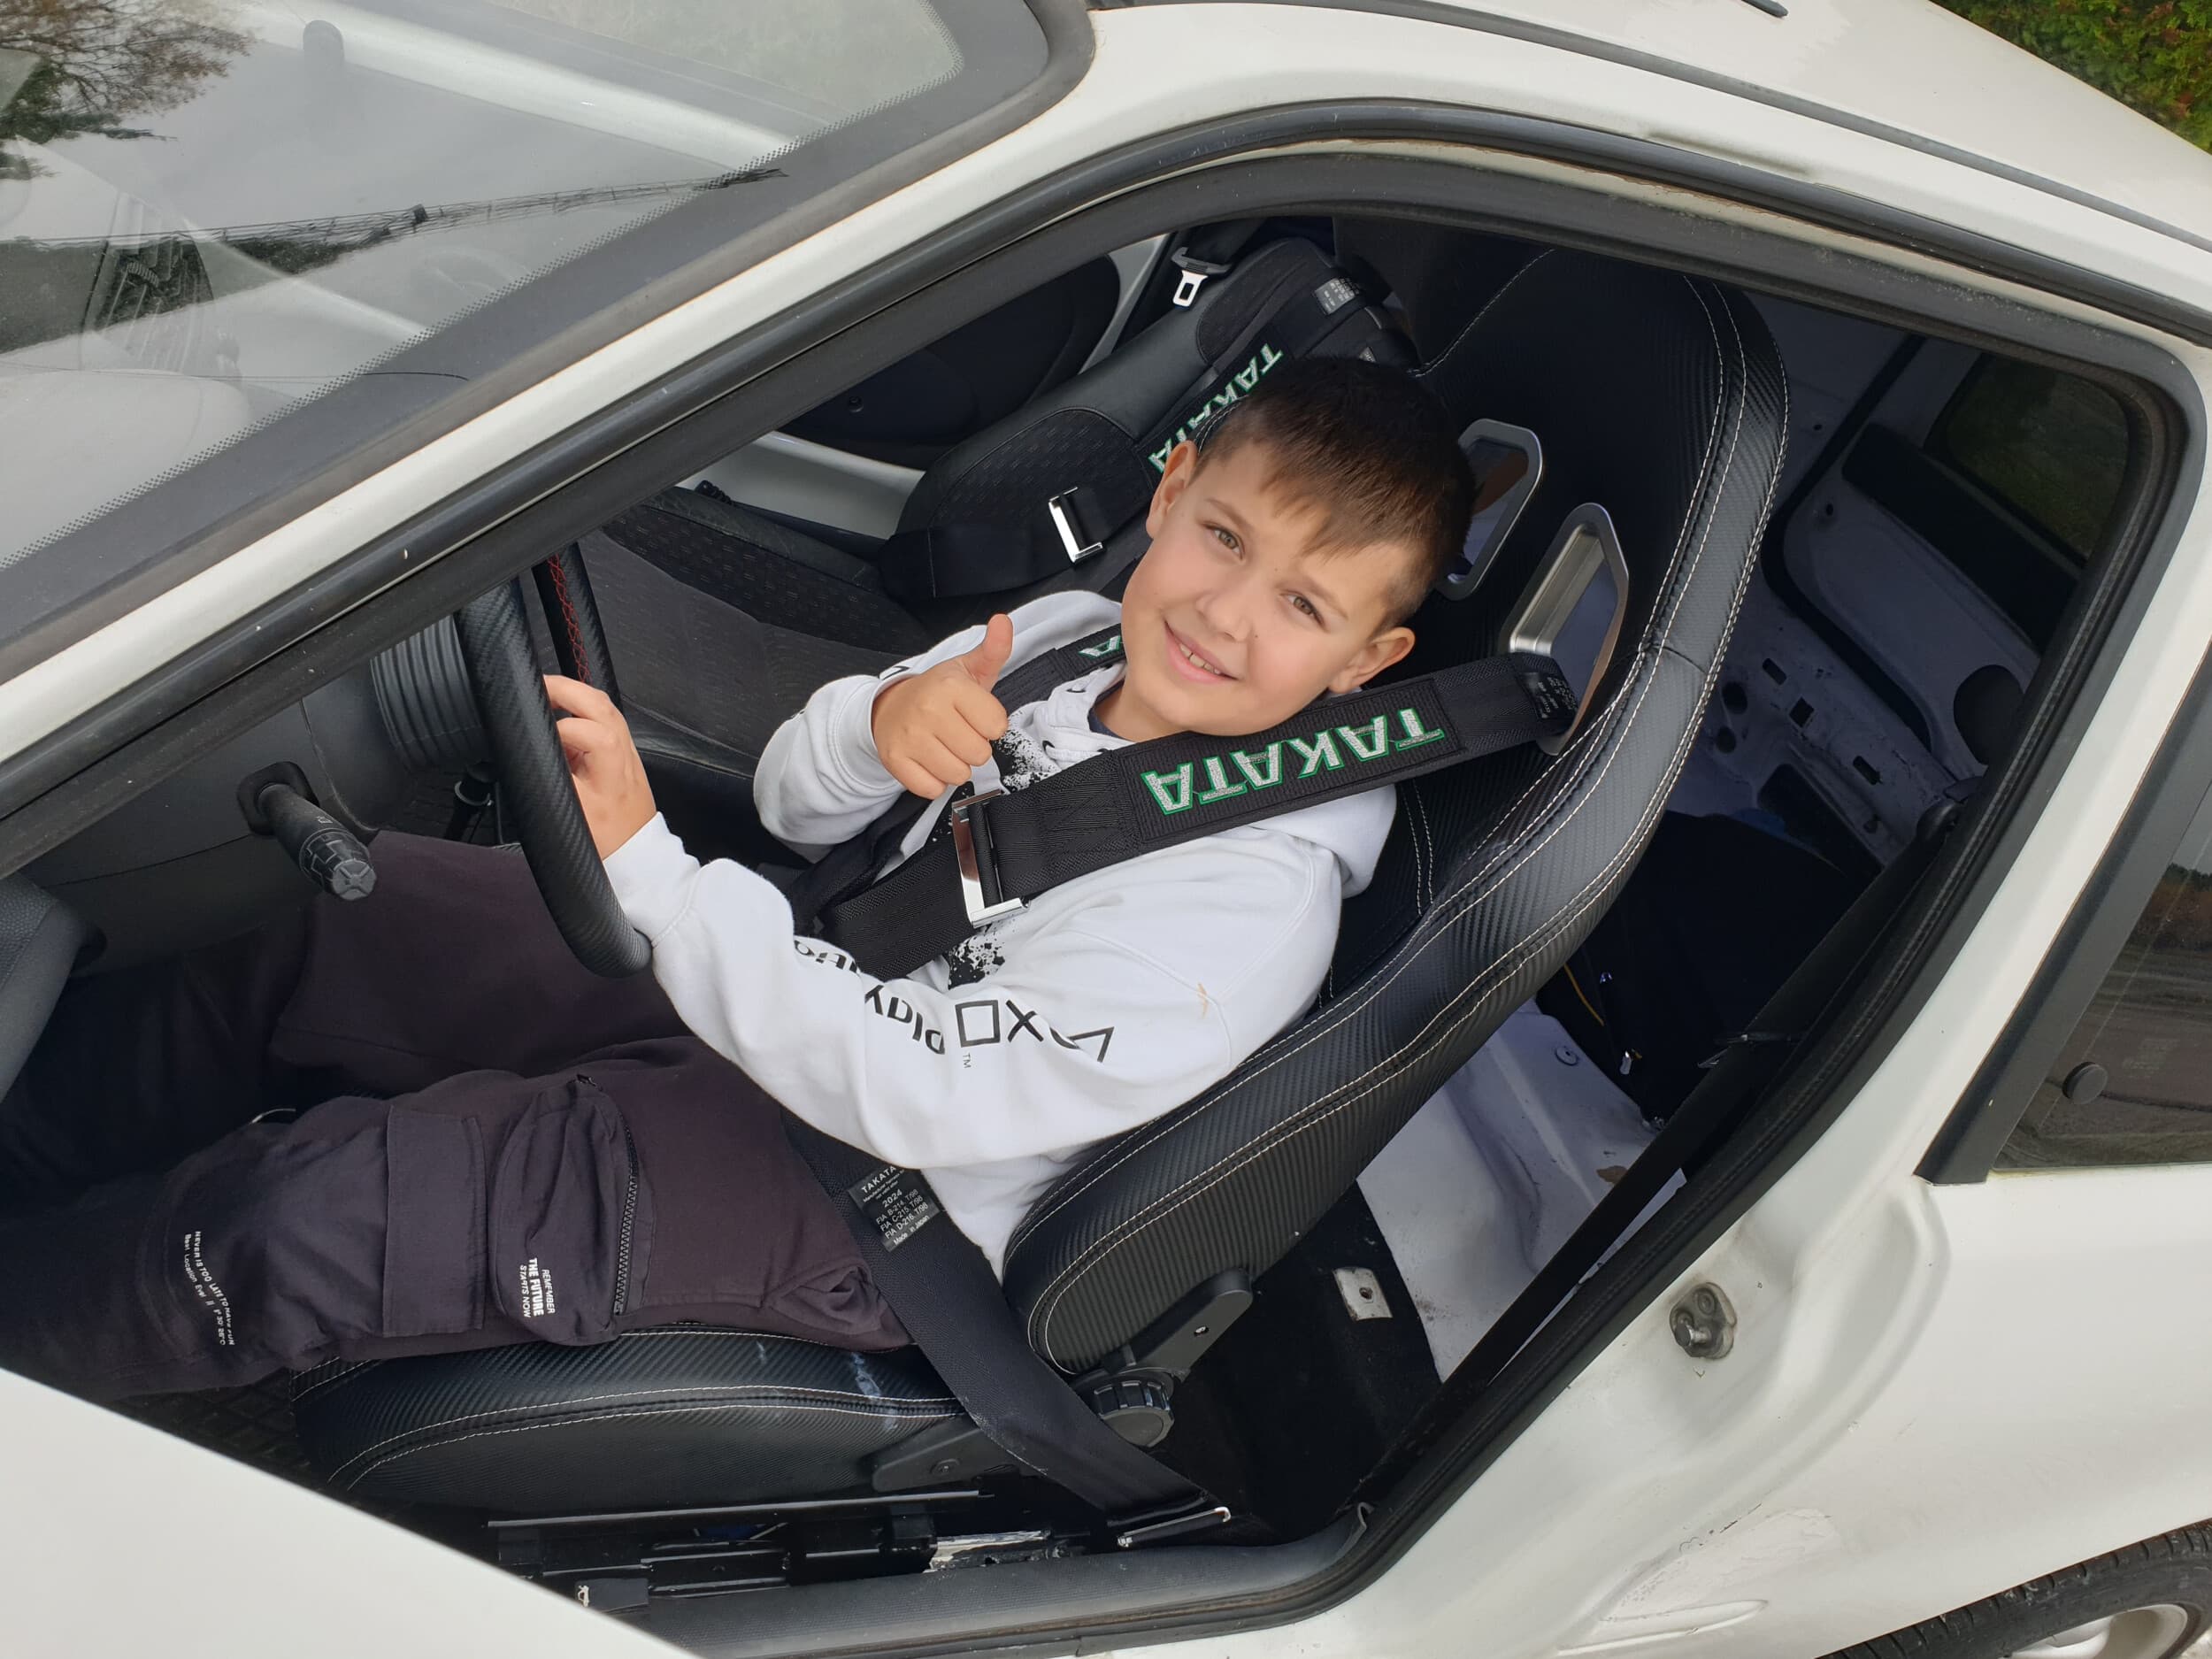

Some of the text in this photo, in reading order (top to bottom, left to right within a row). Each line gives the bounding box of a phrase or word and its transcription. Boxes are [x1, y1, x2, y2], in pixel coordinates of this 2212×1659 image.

[1148, 342, 1284, 473] TAKAA
[1141, 707, 1446, 816] TAKATA
[861, 1165, 897, 1194] TAKATA
[882, 1188, 902, 1208] 2024
[875, 1213, 887, 1225] FIA
[879, 1220, 893, 1232] FIA
[885, 1227, 897, 1240] FIA
[914, 1202, 929, 1216] T/98
[893, 1233, 908, 1246] Made
[915, 1215, 930, 1230] Japan
[184, 1254, 197, 1282] Location
[199, 1267, 212, 1282] TOO
[209, 1282, 224, 1298] LATE
[219, 1297, 229, 1307] TO
[528, 1257, 544, 1317] THE FUTURE
[519, 1264, 532, 1317] STARTS NOW
[541, 1269, 556, 1314] REMEMBER
